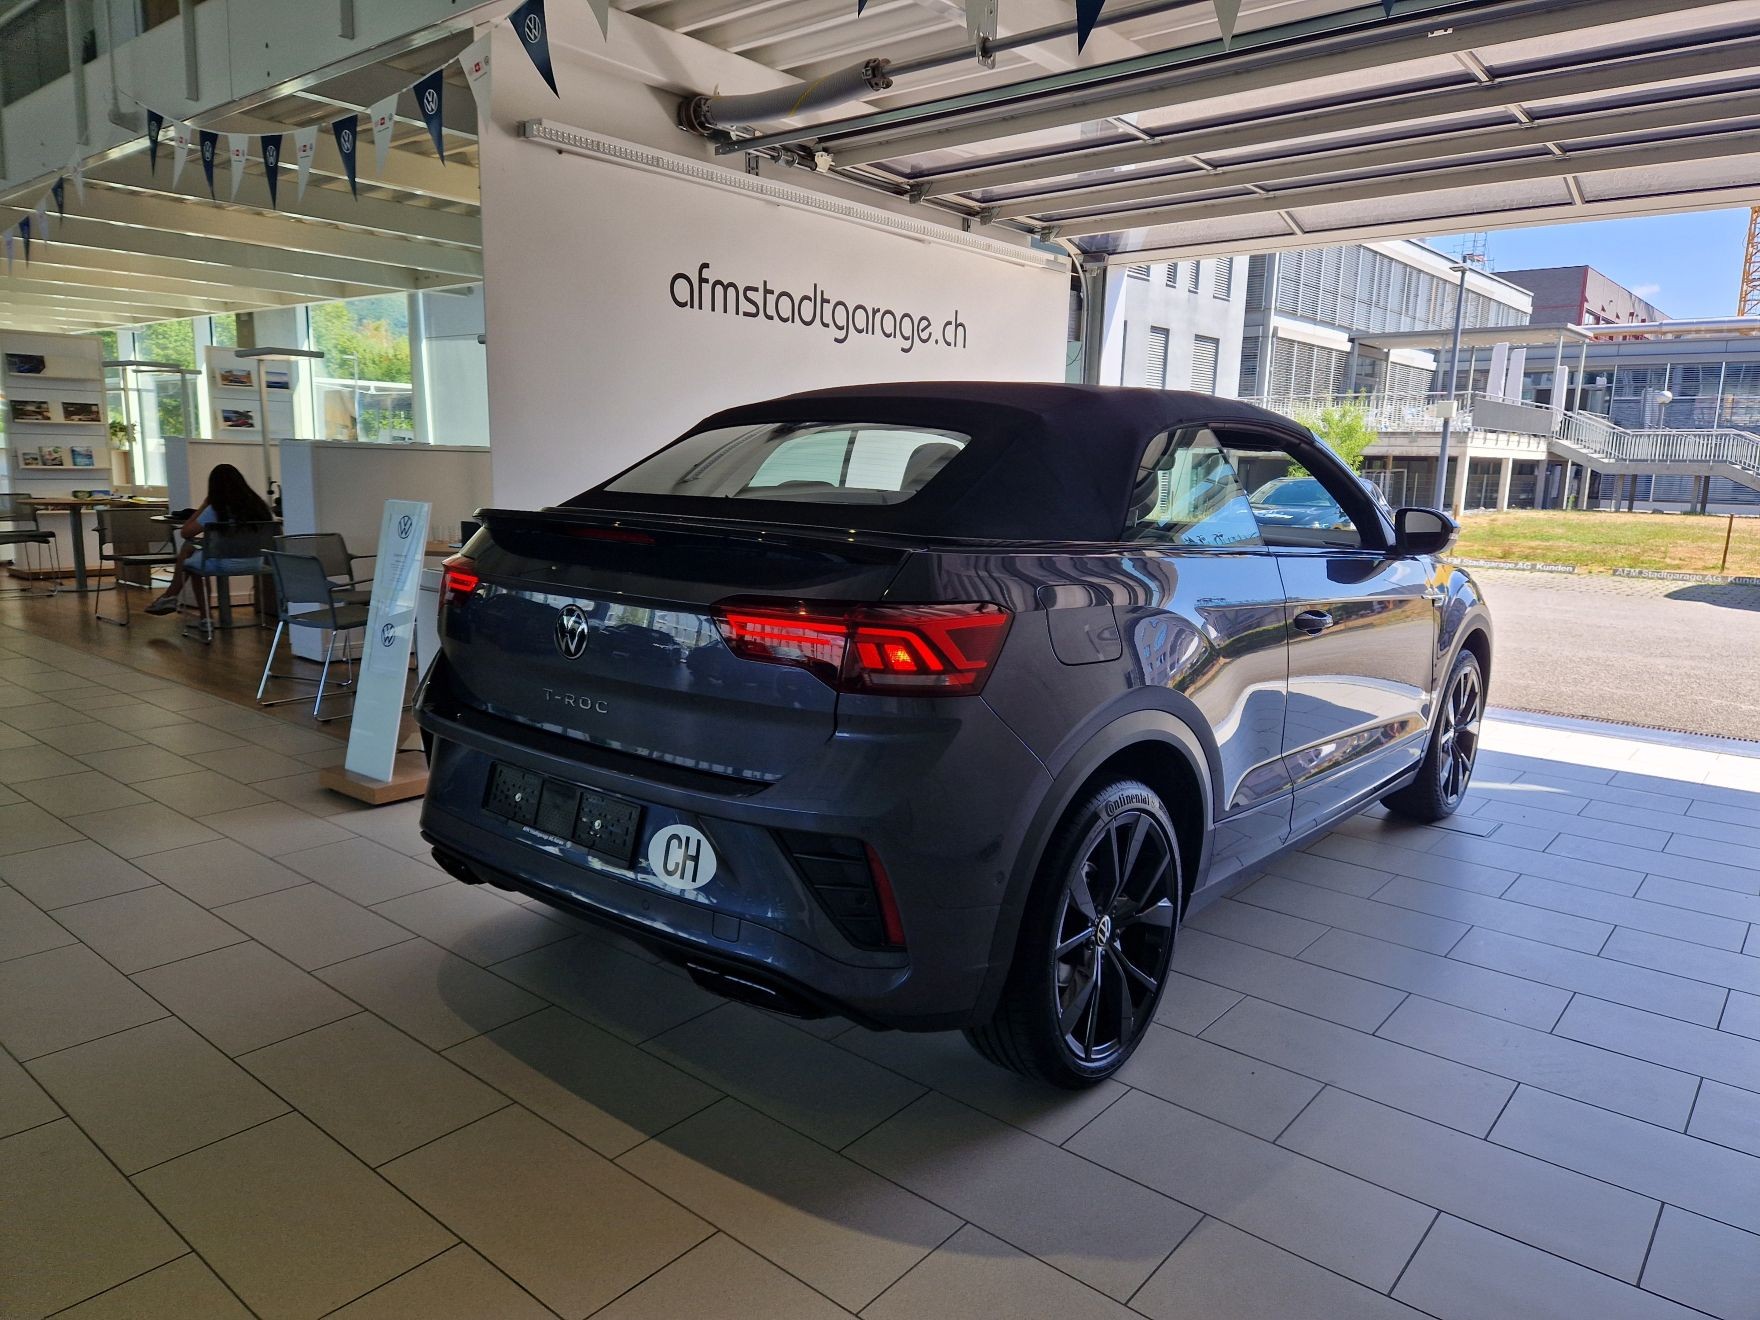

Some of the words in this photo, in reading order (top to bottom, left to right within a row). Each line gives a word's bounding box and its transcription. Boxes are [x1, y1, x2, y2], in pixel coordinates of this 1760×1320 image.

[669, 262, 967, 353] afmstadtgarage.ch
[1463, 559, 1517, 570] Stadtgarage
[1516, 562, 1532, 570] AG
[1535, 562, 1574, 572] Kunden
[1615, 568, 1639, 578] AFM
[1641, 569, 1702, 583] Stadtgarage
[1704, 574, 1722, 583] AG
[543, 688, 609, 714] T-ROC
[1105, 793, 1150, 817] Continental
[662, 833, 702, 883] CH
